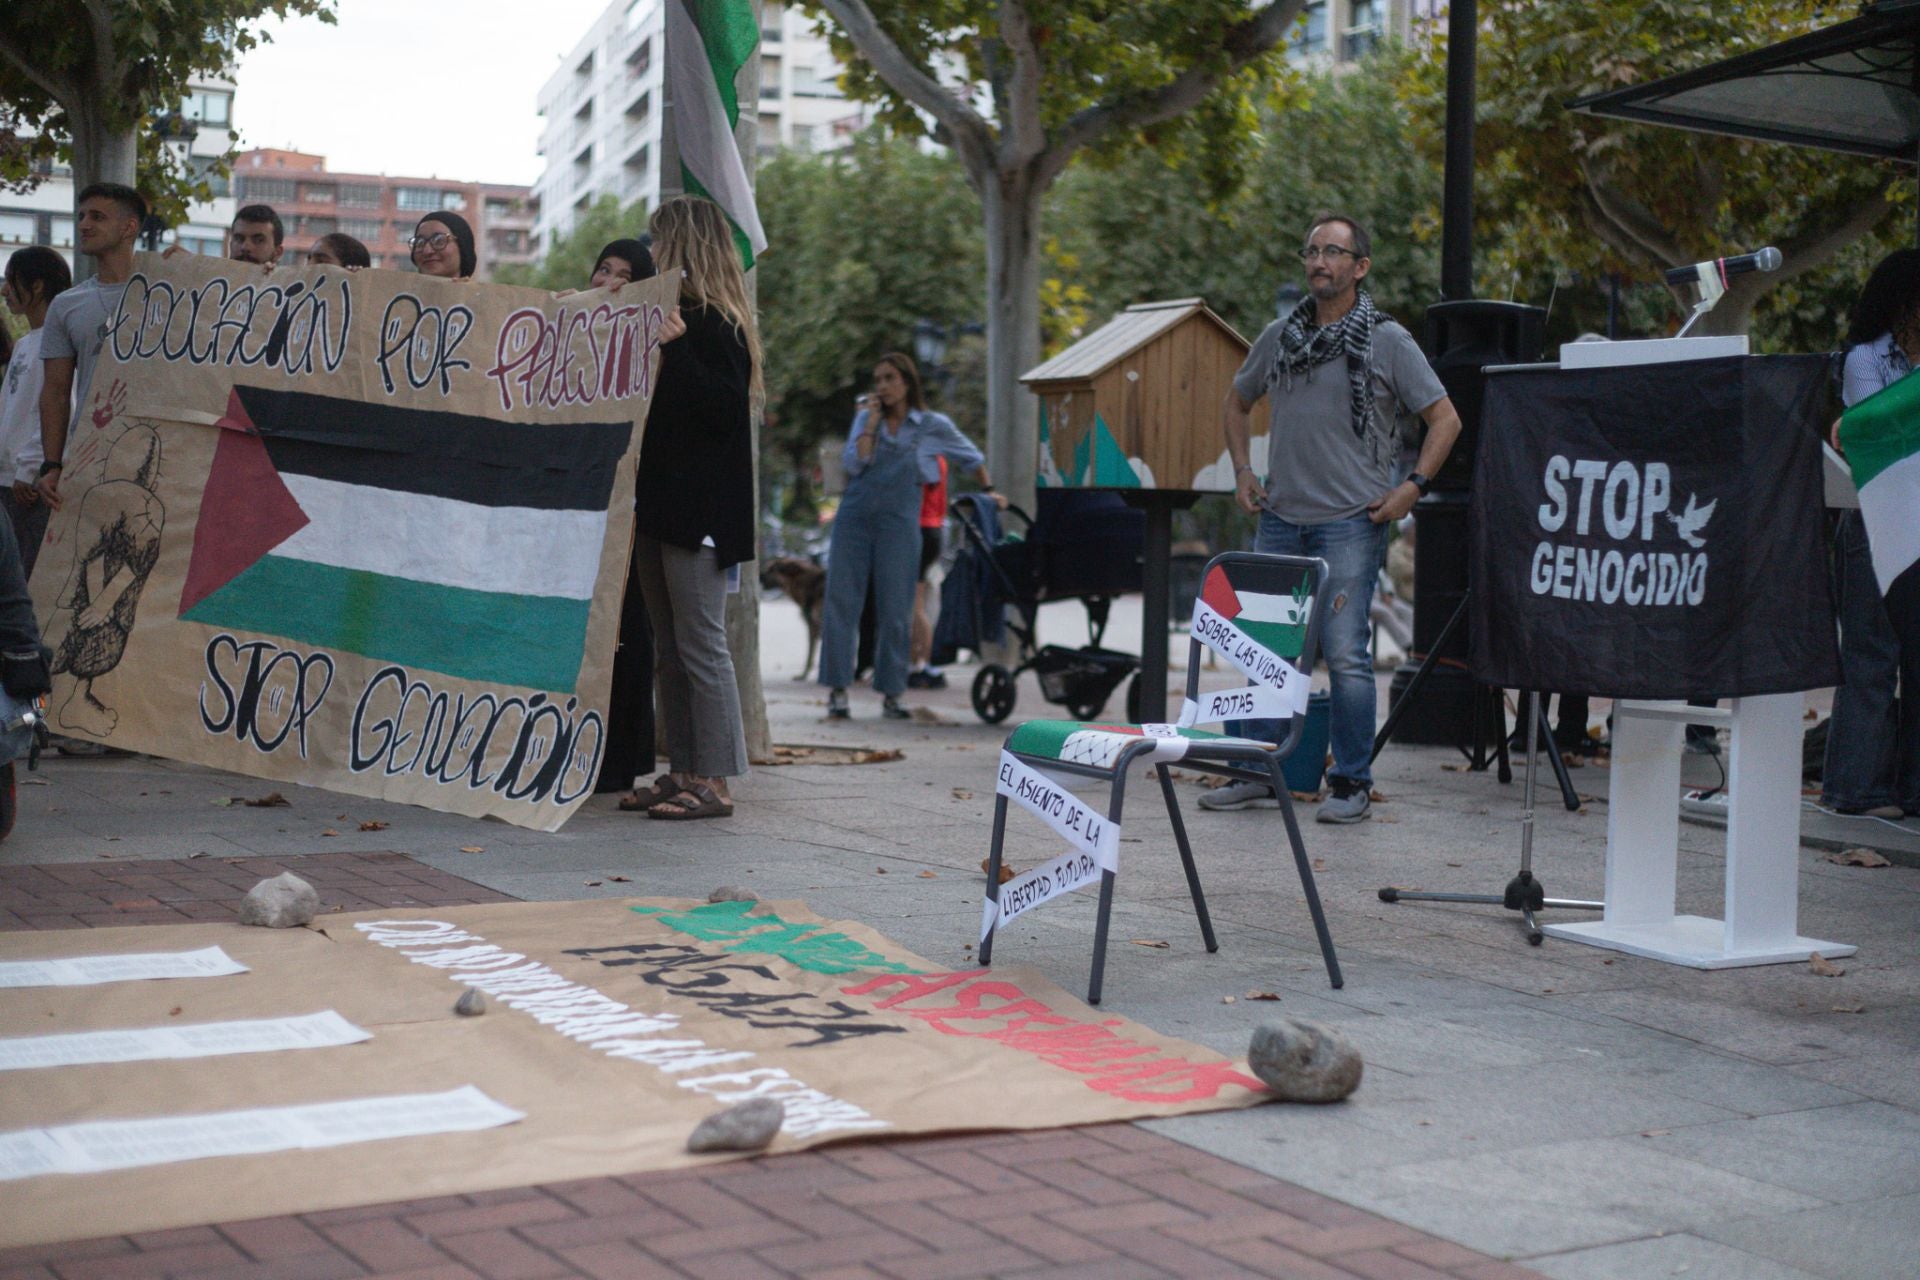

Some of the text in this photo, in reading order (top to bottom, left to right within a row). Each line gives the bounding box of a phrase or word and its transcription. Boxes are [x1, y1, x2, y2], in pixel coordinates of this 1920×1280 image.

[375, 292, 475, 397] POR
[1538, 454, 1671, 541] STOP
[1531, 541, 1709, 606] GENOCIDIO
[1196, 612, 1238, 652] SOBRE
[1234, 641, 1258, 668] LAS
[199, 632, 605, 807] STOP GENOCIDIO
[1210, 693, 1254, 718] ROTAS
[999, 763, 1101, 848] EL ASIENTO DE LA
[1055, 854, 1096, 889] FUTURA
